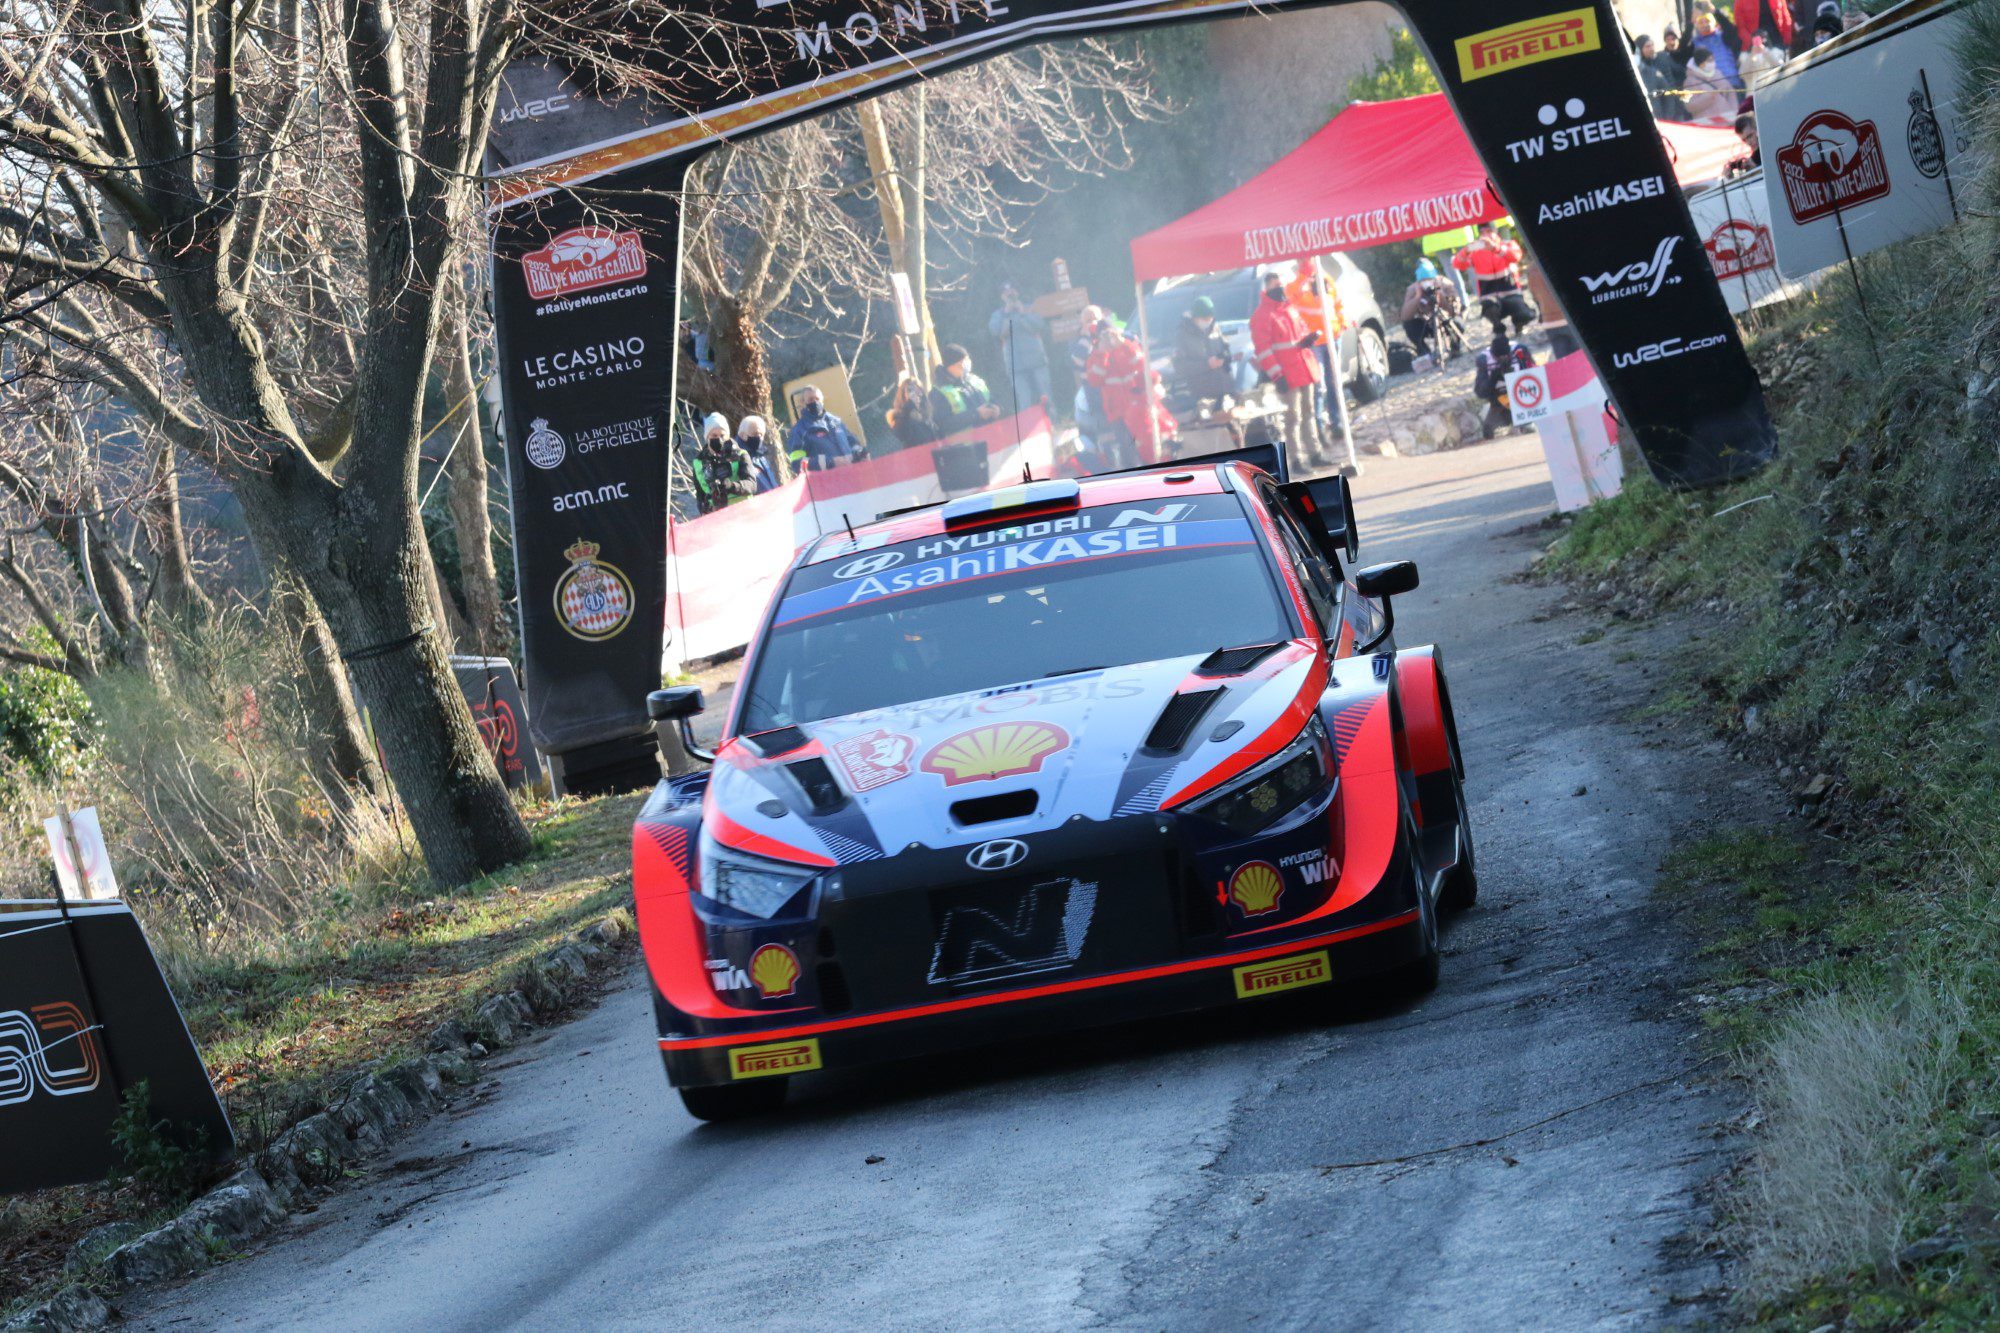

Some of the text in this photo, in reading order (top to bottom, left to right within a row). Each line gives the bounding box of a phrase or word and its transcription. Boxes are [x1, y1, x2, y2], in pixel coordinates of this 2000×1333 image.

[1470, 18, 1584, 70] PIRELLI
[500, 94, 570, 122] WRC
[1506, 117, 1631, 164] TW STEEL
[1786, 172, 1824, 213] RALLYE
[1243, 188, 1484, 260] AUTOMOBILE CLUB DE MONACO
[529, 266, 569, 294] RALLYE
[1592, 282, 1649, 305] LUBRICANTS
[536, 285, 648, 317] #RallyeMonteCarlo
[524, 337, 645, 378] LE CASINO
[575, 416, 655, 443] LA BOUTIQUE
[578, 427, 657, 454] OFFICIELLE
[553, 482, 629, 512] acm.mc
[917, 516, 1092, 560] HYUNDAI
[911, 679, 1145, 728] MOBIS
[1242, 958, 1324, 991] PIRELLI
[737, 1045, 812, 1074] PIRELLI
